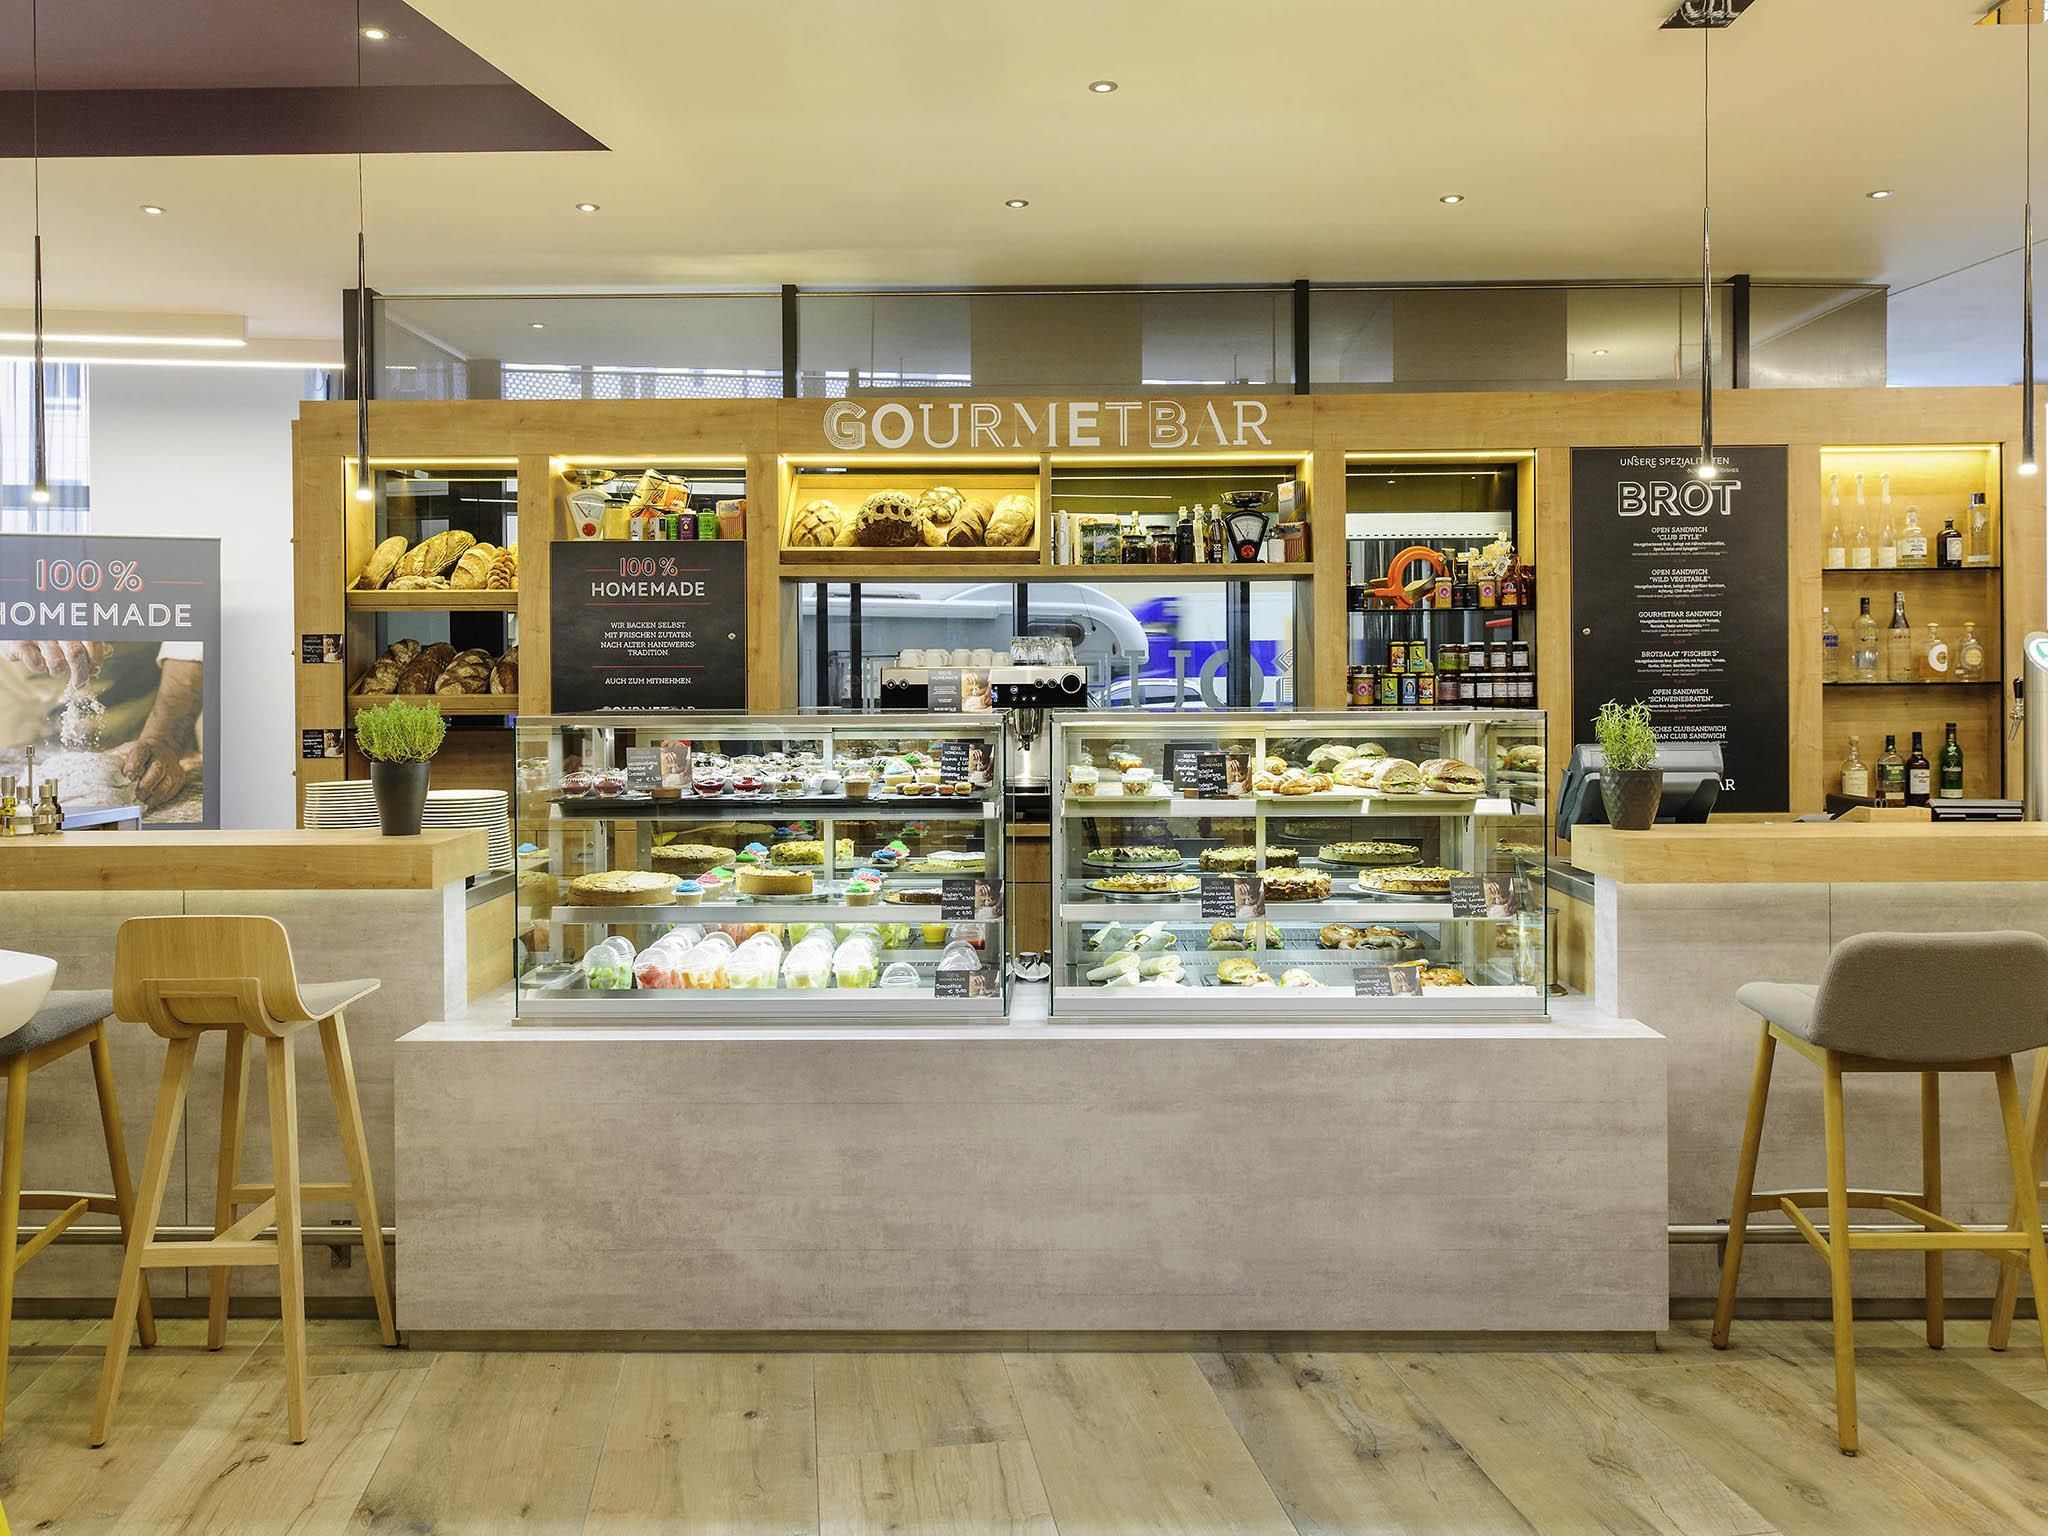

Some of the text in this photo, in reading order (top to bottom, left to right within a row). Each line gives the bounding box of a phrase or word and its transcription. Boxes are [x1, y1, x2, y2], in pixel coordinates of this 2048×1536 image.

[823, 400, 1272, 449] GOURMETBAR
[1620, 456, 1657, 468] UNSERE
[1617, 480, 1741, 517] BROT
[36, 559, 144, 592] 100 %
[620, 557, 679, 577] 100 %
[591, 582, 705, 597] HOMEMADE
[0, 602, 193, 627] OMEMADE
[605, 677, 627, 685] AUCH
[628, 677, 645, 685] ZUM
